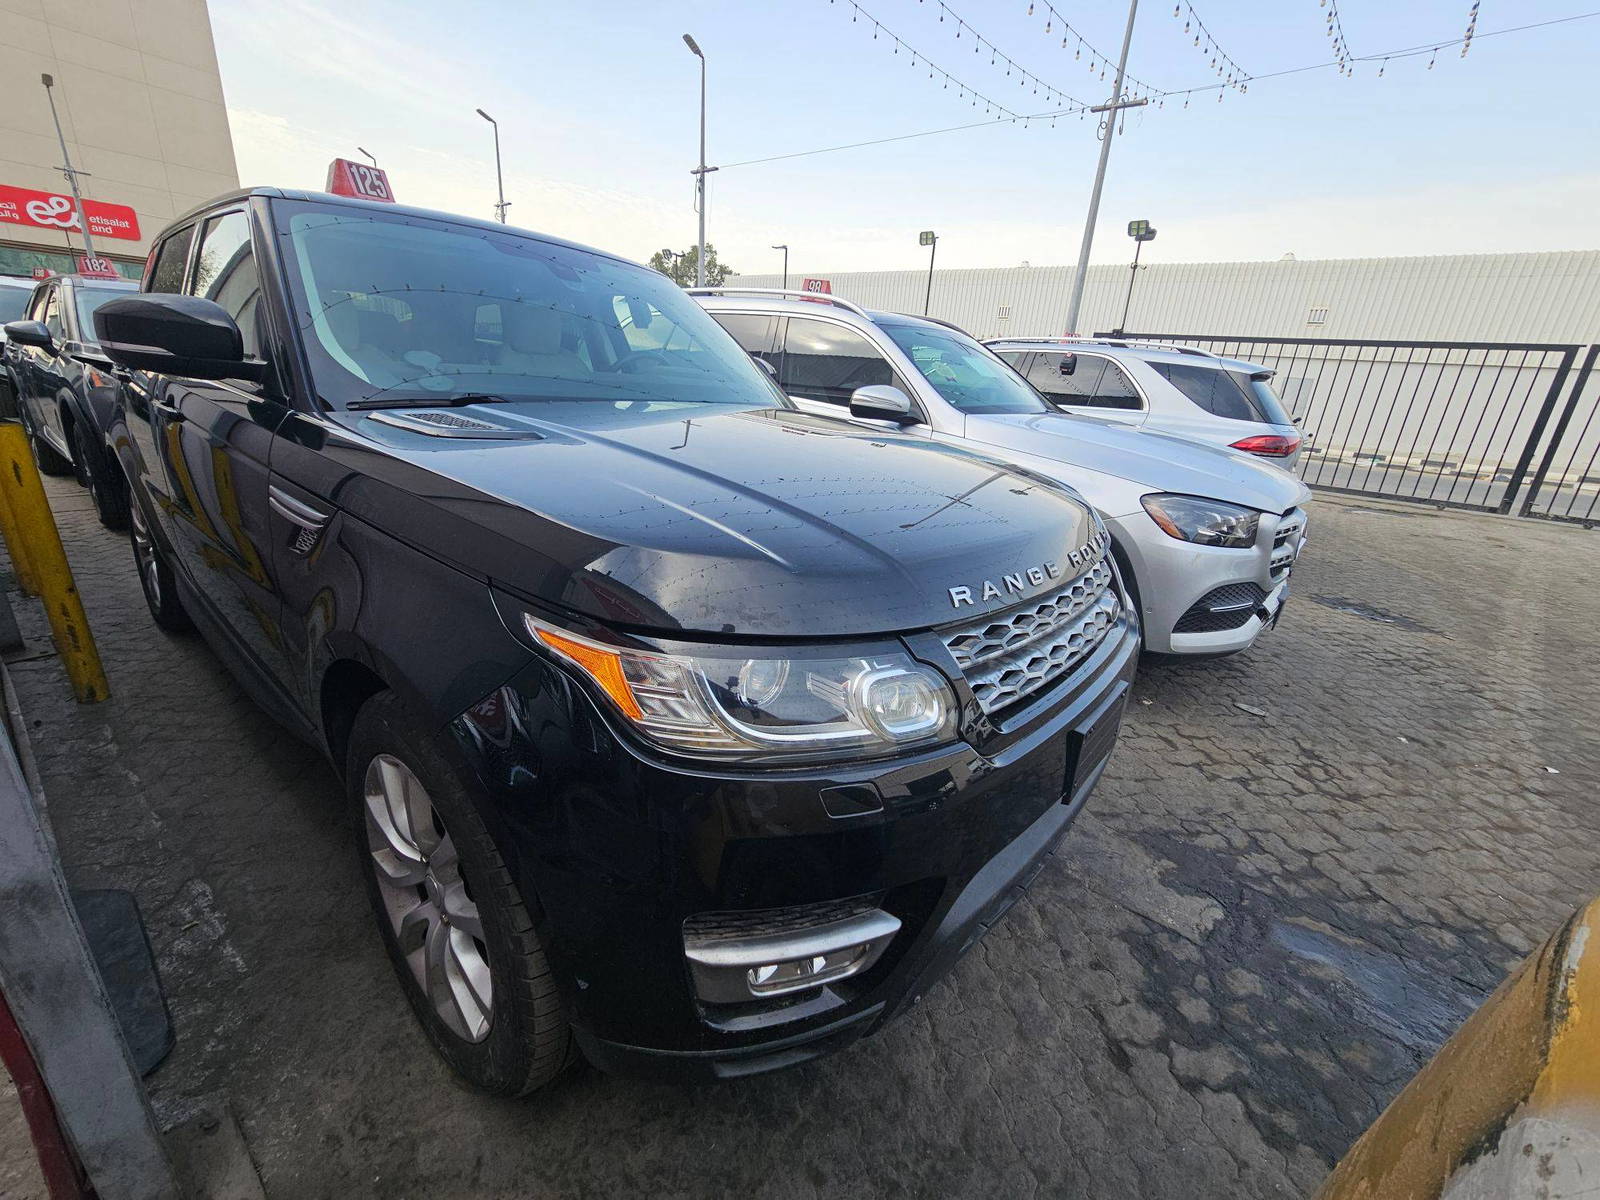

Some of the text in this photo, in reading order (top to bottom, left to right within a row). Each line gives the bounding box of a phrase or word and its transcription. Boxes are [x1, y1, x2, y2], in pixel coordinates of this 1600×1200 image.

[350, 164, 389, 199] 125
[88, 215, 130, 228] etisalat
[91, 224, 113, 234] and
[85, 258, 109, 272] 182
[808, 280, 822, 293] 98
[948, 533, 1107, 608] RANGE ROVE
